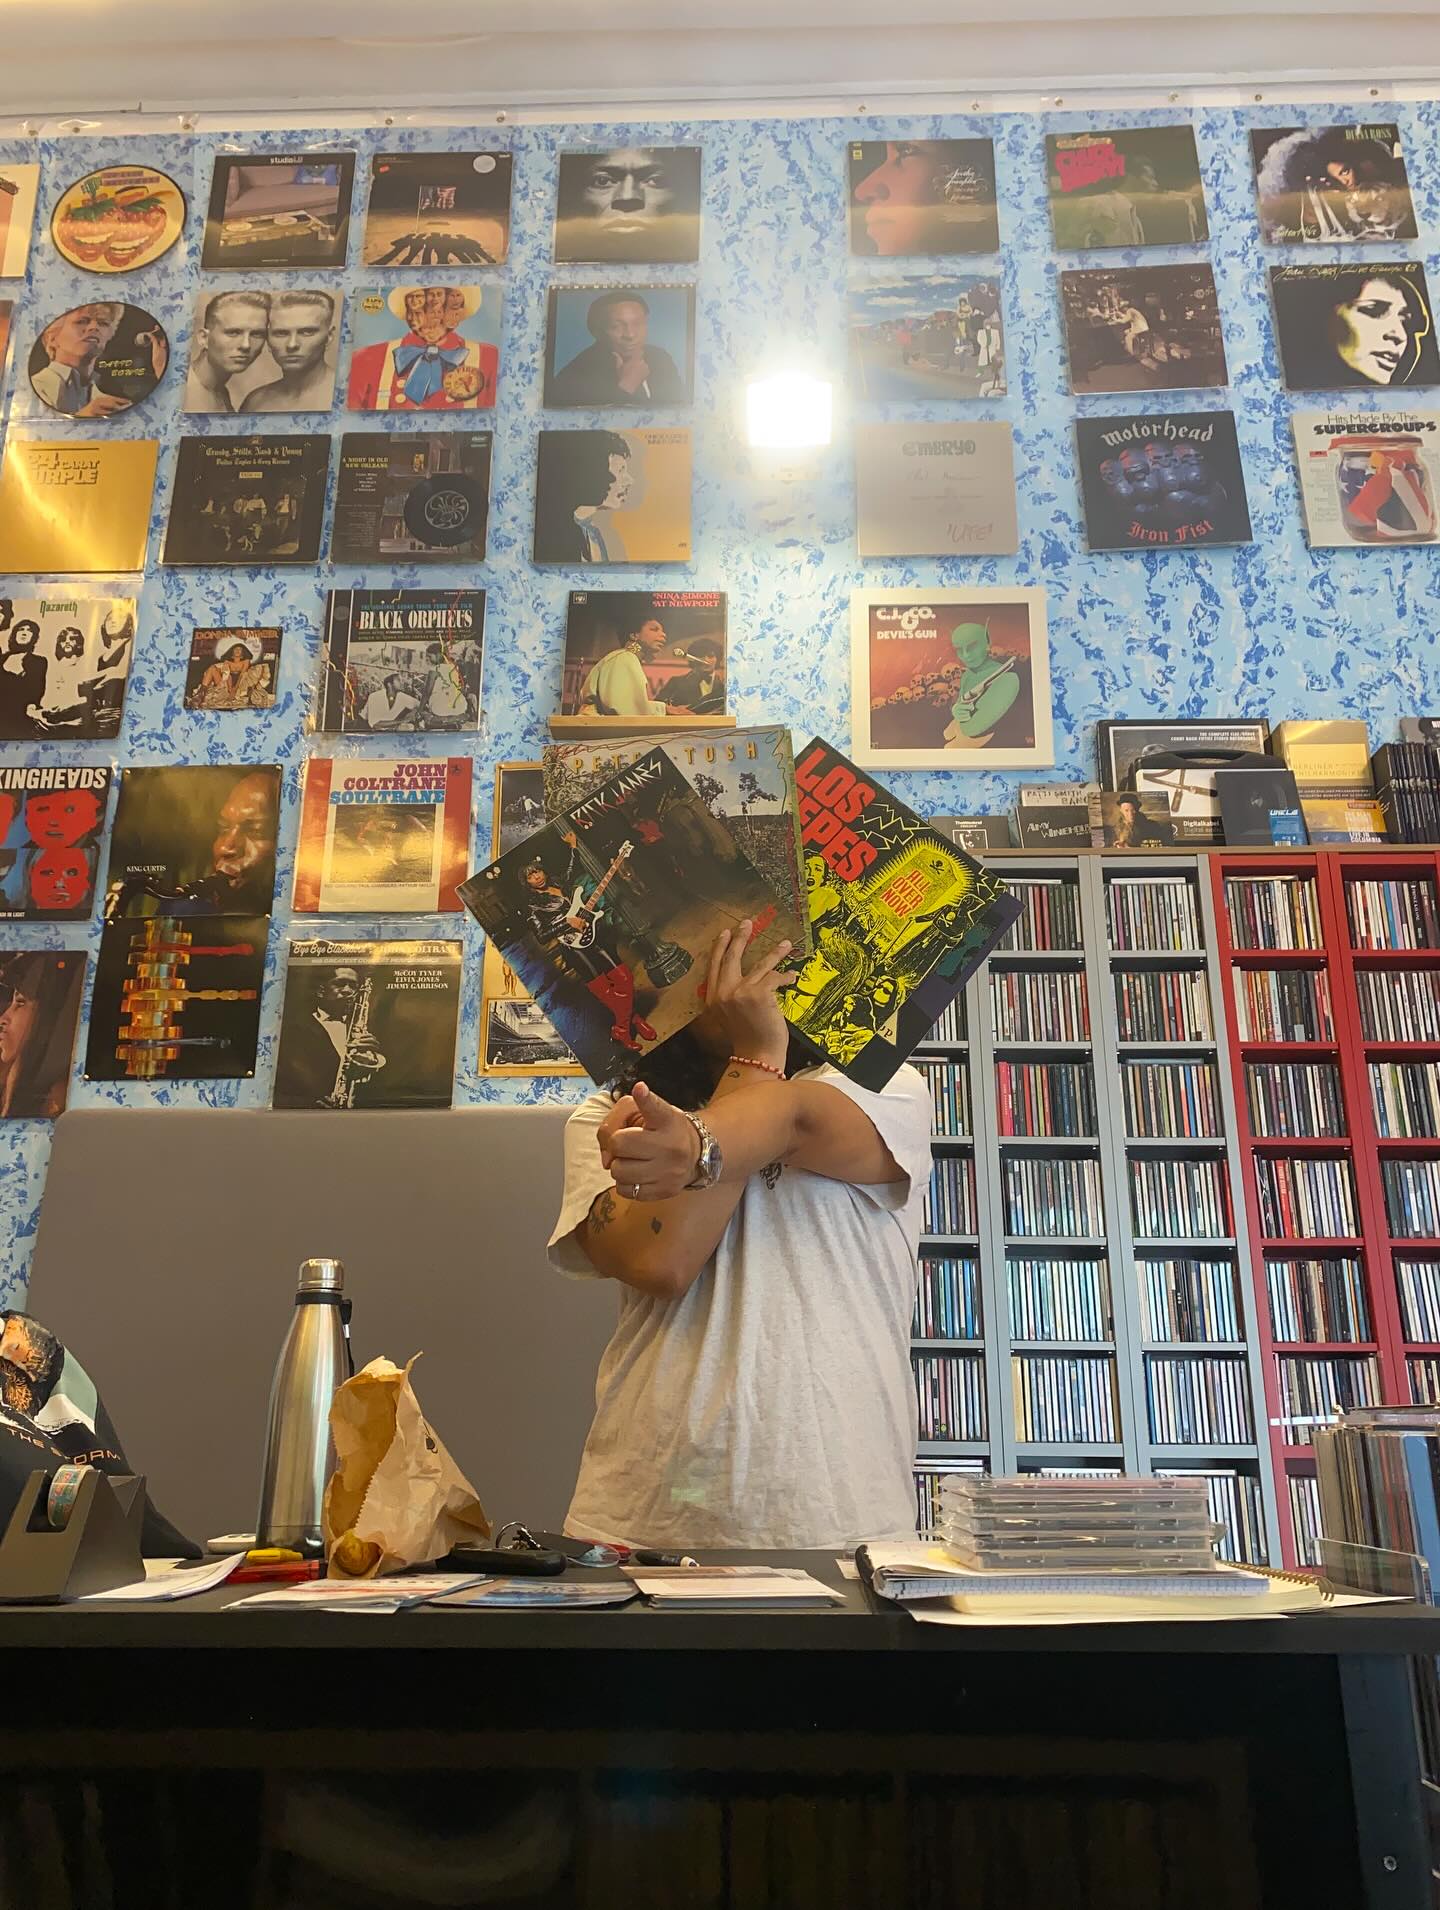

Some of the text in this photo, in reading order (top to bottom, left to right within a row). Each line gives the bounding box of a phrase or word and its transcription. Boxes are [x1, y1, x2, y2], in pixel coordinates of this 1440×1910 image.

[1327, 411, 1418, 425] Hits Made By The
[1313, 421, 1437, 435] SUPERGROUPS
[1175, 519, 1214, 543] Fist
[681, 592, 720, 600] SIMONE
[40, 600, 78, 618] Nazareth
[668, 600, 719, 608] NEWPORT
[359, 608, 473, 630] BLACK ORPHEUS
[195, 630, 234, 640] DONNA
[876, 629, 937, 640] DEVIL'S GUN
[393, 763, 447, 778] JOHN
[343, 777, 446, 791] COLTRANE
[795, 747, 876, 823] LOS
[330, 790, 445, 805] SOULTRANE
[1054, 790, 1083, 798] SMITH
[1026, 821, 1050, 833] AMY
[798, 788, 879, 882] EPES
[905, 869, 931, 895] ALL
[891, 876, 924, 910] OVER
[880, 888, 911, 919] NOW
[310, 944, 326, 957] Bye
[7, 1427, 45, 1448] THE
